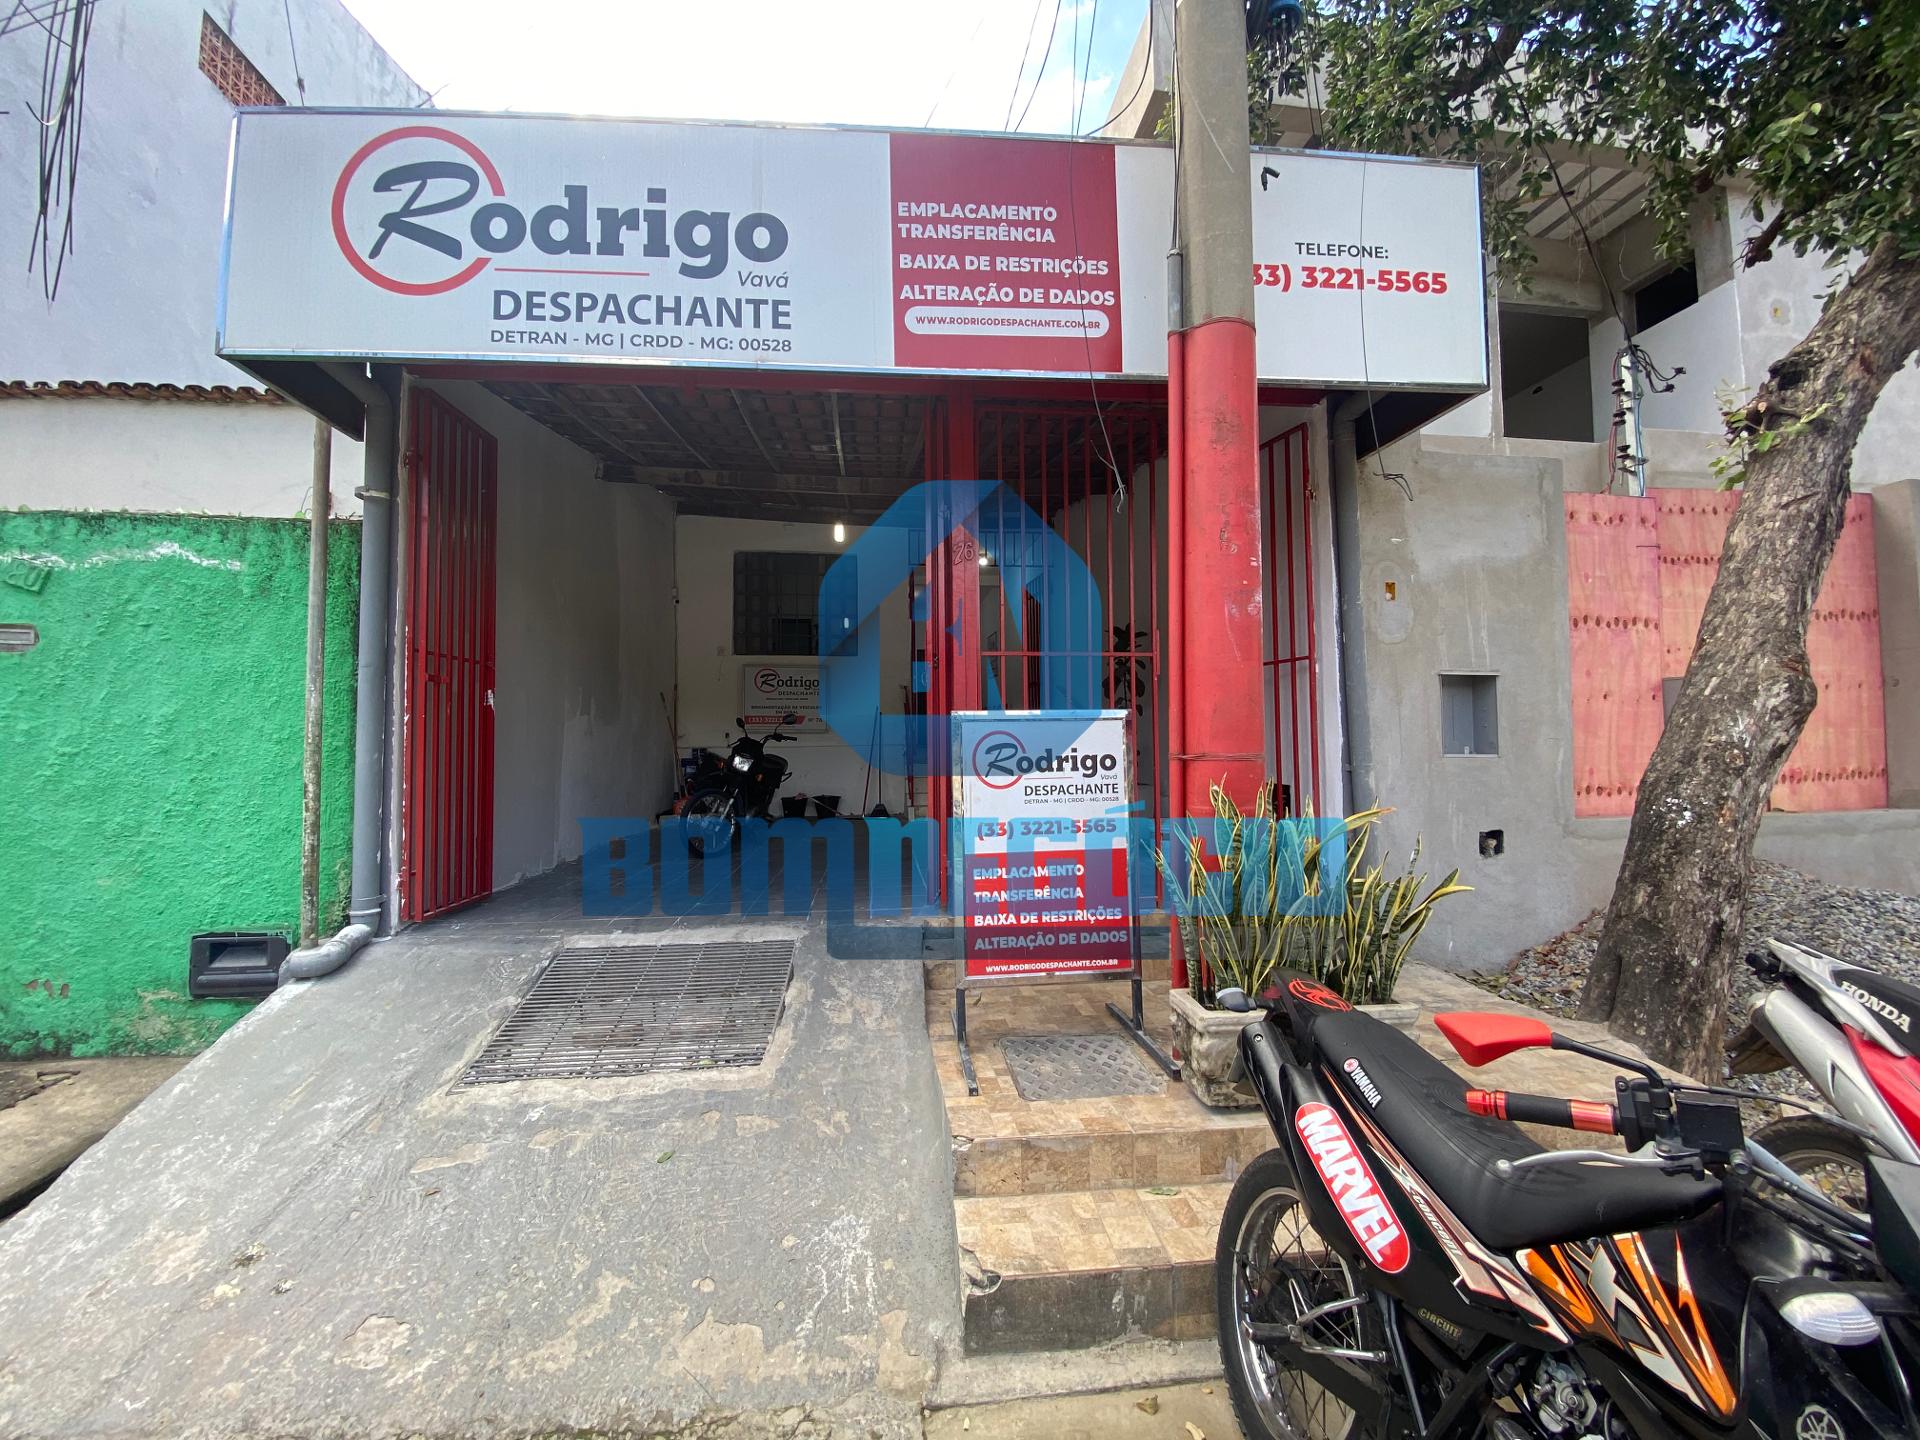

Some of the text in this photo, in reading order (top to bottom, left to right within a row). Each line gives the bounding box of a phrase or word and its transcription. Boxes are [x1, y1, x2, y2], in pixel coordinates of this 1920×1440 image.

[368, 160, 789, 280] Rodrigo
[897, 202, 1057, 222] EMPLACAMENTO
[897, 222, 1056, 243] TRANSFERÊNCIA
[1295, 242, 1389, 259] TELEFONE:
[899, 253, 1109, 278] BAIXA DE RESTRIÇÕES
[737, 270, 789, 289] Vavá
[1301, 266, 1448, 294] 3221-5565
[900, 282, 1115, 306] ALTERAÇÃO DE DADOS
[492, 289, 792, 330] DESPACHANTE
[915, 316, 1101, 330] WWW.RODRIGODESPACHANTE.COM.BR
[490, 329, 567, 346] DETRAN
[584, 332, 614, 347] MG
[629, 334, 683, 349] CRDD
[700, 336, 733, 350] MG:
[738, 337, 792, 352] 00528
[759, 673, 820, 690] Rodrigo
[985, 742, 1117, 778] Rodrigo
[1024, 783, 1119, 796] DESPACHANTE
[977, 818, 1117, 841] (33) 3221-5565
[973, 864, 1085, 880] EMPLACAMENTO
[973, 885, 1084, 903] TRANSFERÊNCIA
[974, 906, 1122, 927] BAIXA DE RESTRIÇÕES
[974, 930, 1128, 950] ALTERAÇÃO DE DADOS
[1840, 981, 1911, 1033] HONDA
[1350, 1066, 1382, 1109] YAMAHA
[1298, 1109, 1400, 1264] MARVEL
[1418, 1308, 1461, 1338] CIRCUIT
